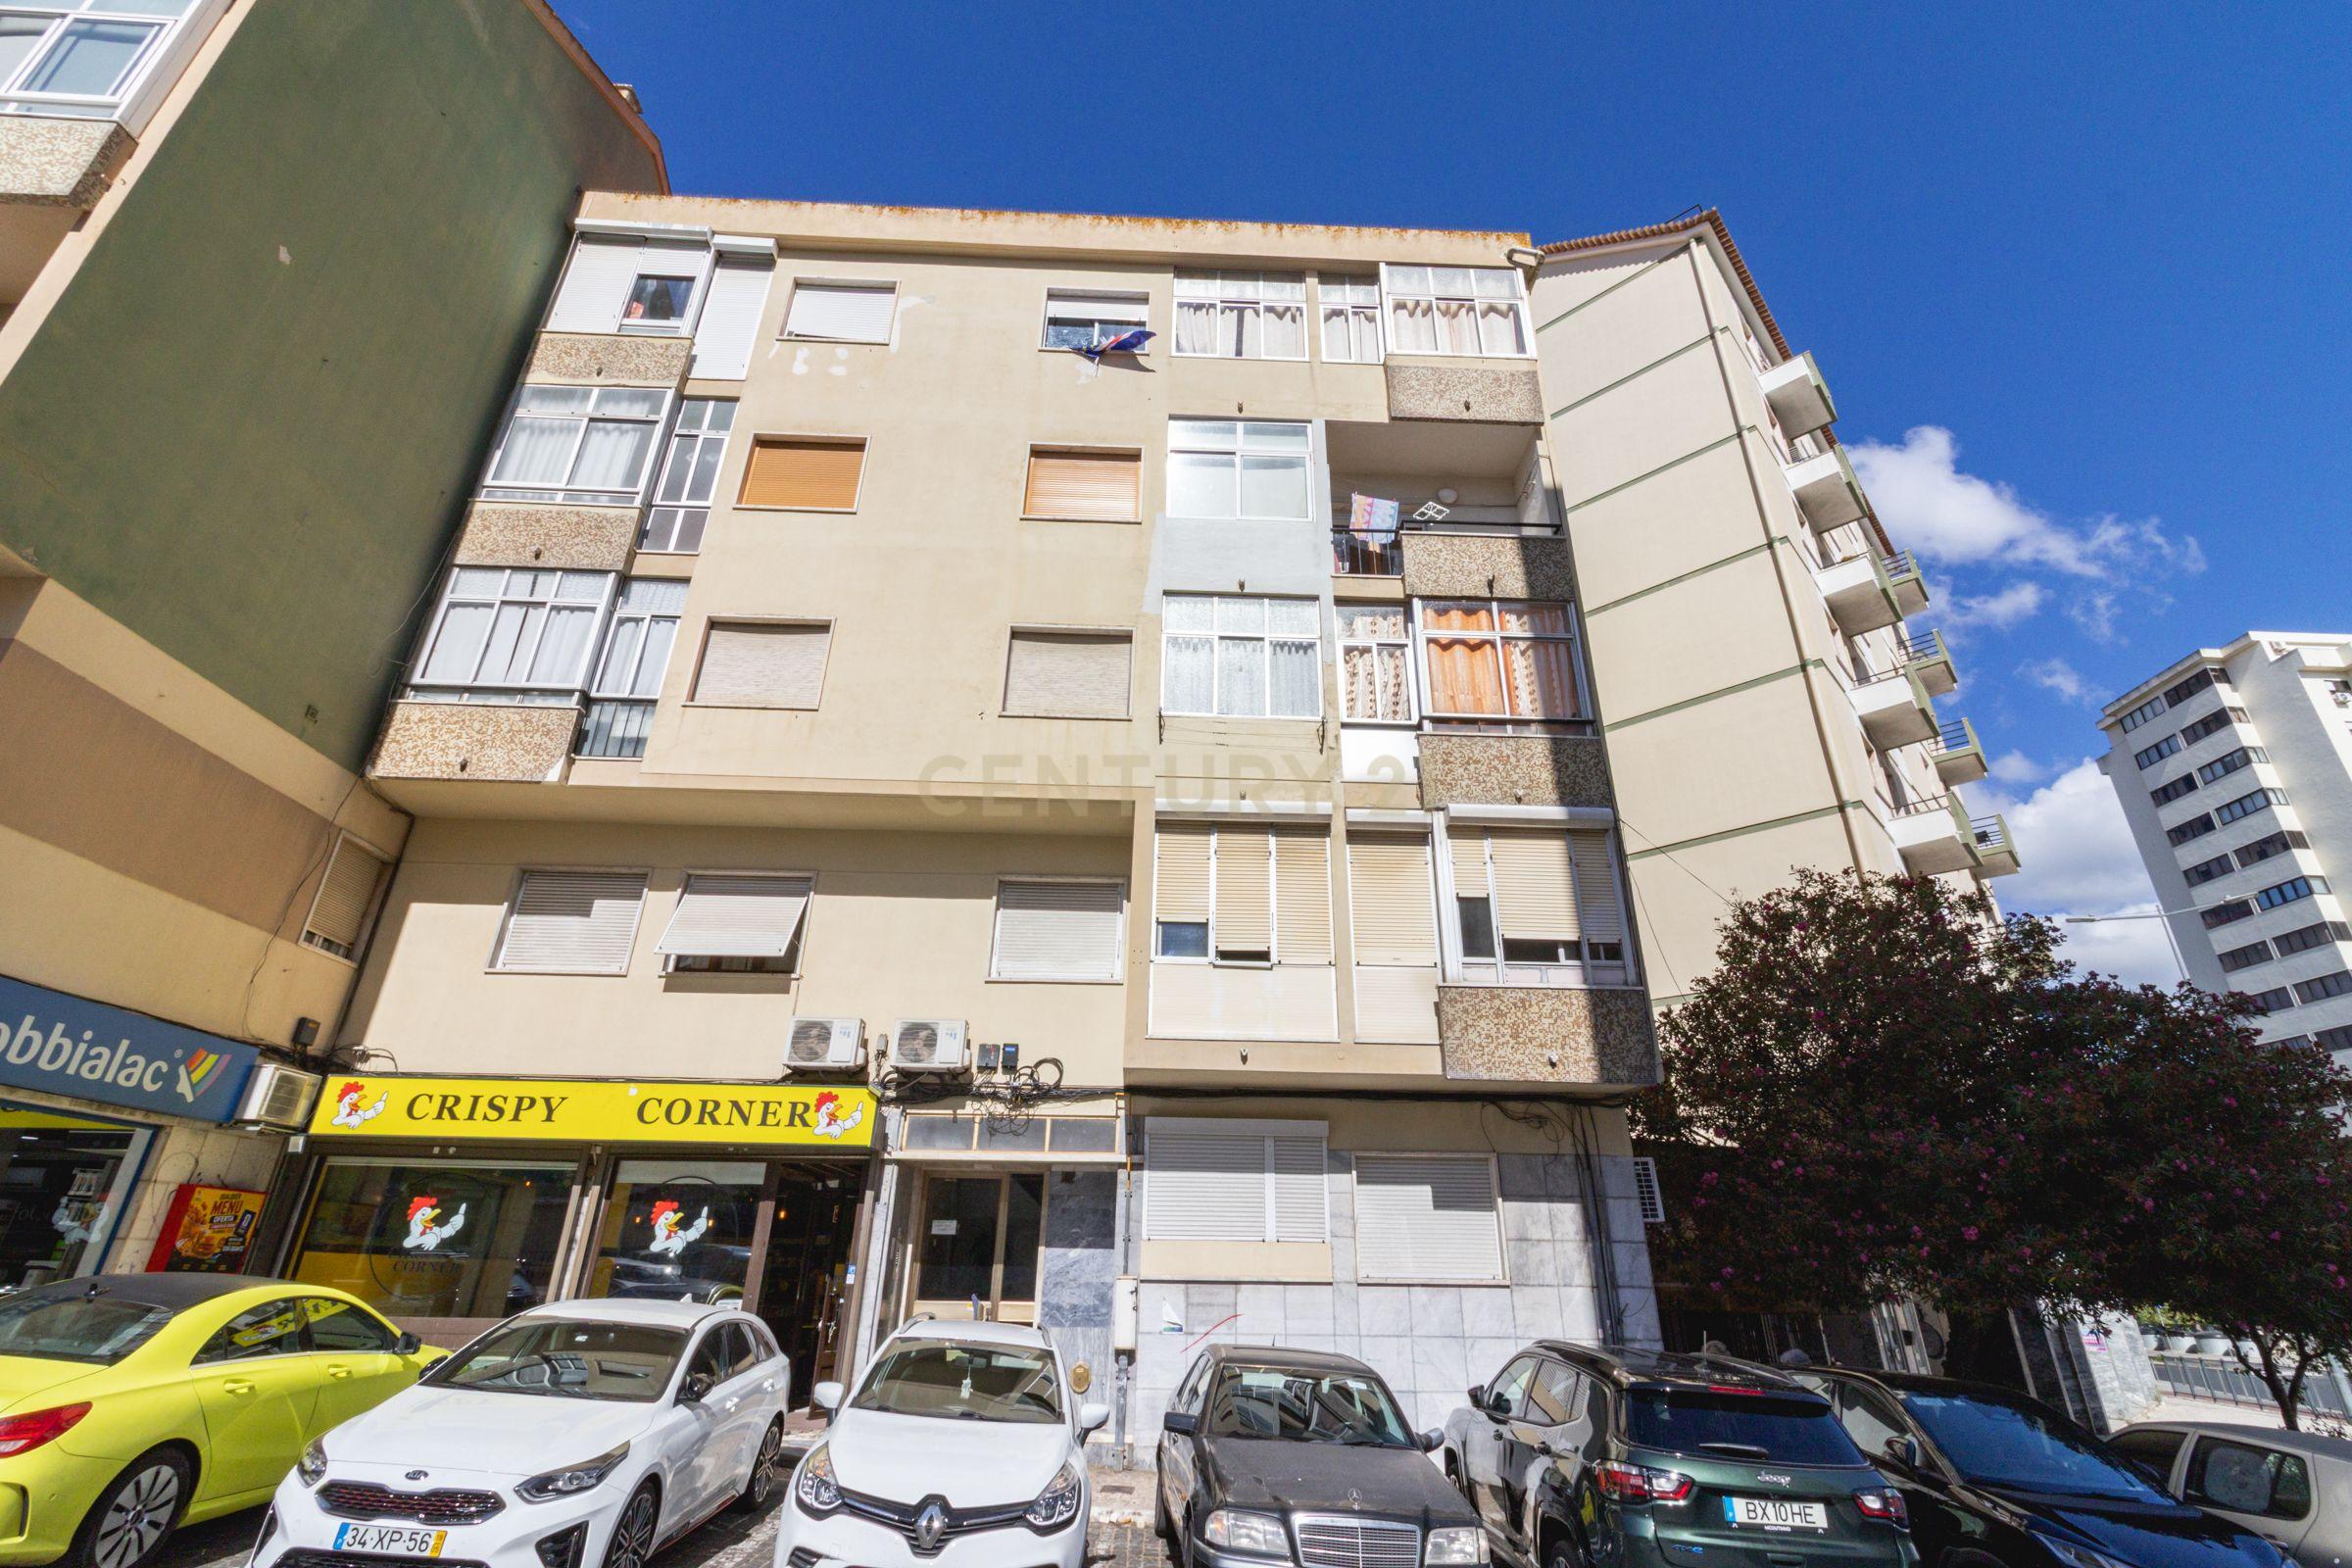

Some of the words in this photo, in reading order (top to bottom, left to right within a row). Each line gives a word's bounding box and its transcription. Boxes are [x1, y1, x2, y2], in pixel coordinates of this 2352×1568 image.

[406, 1093, 568, 1123] CRISPY
[636, 1097, 812, 1128] CORNER
[211, 1200, 244, 1215] MENU
